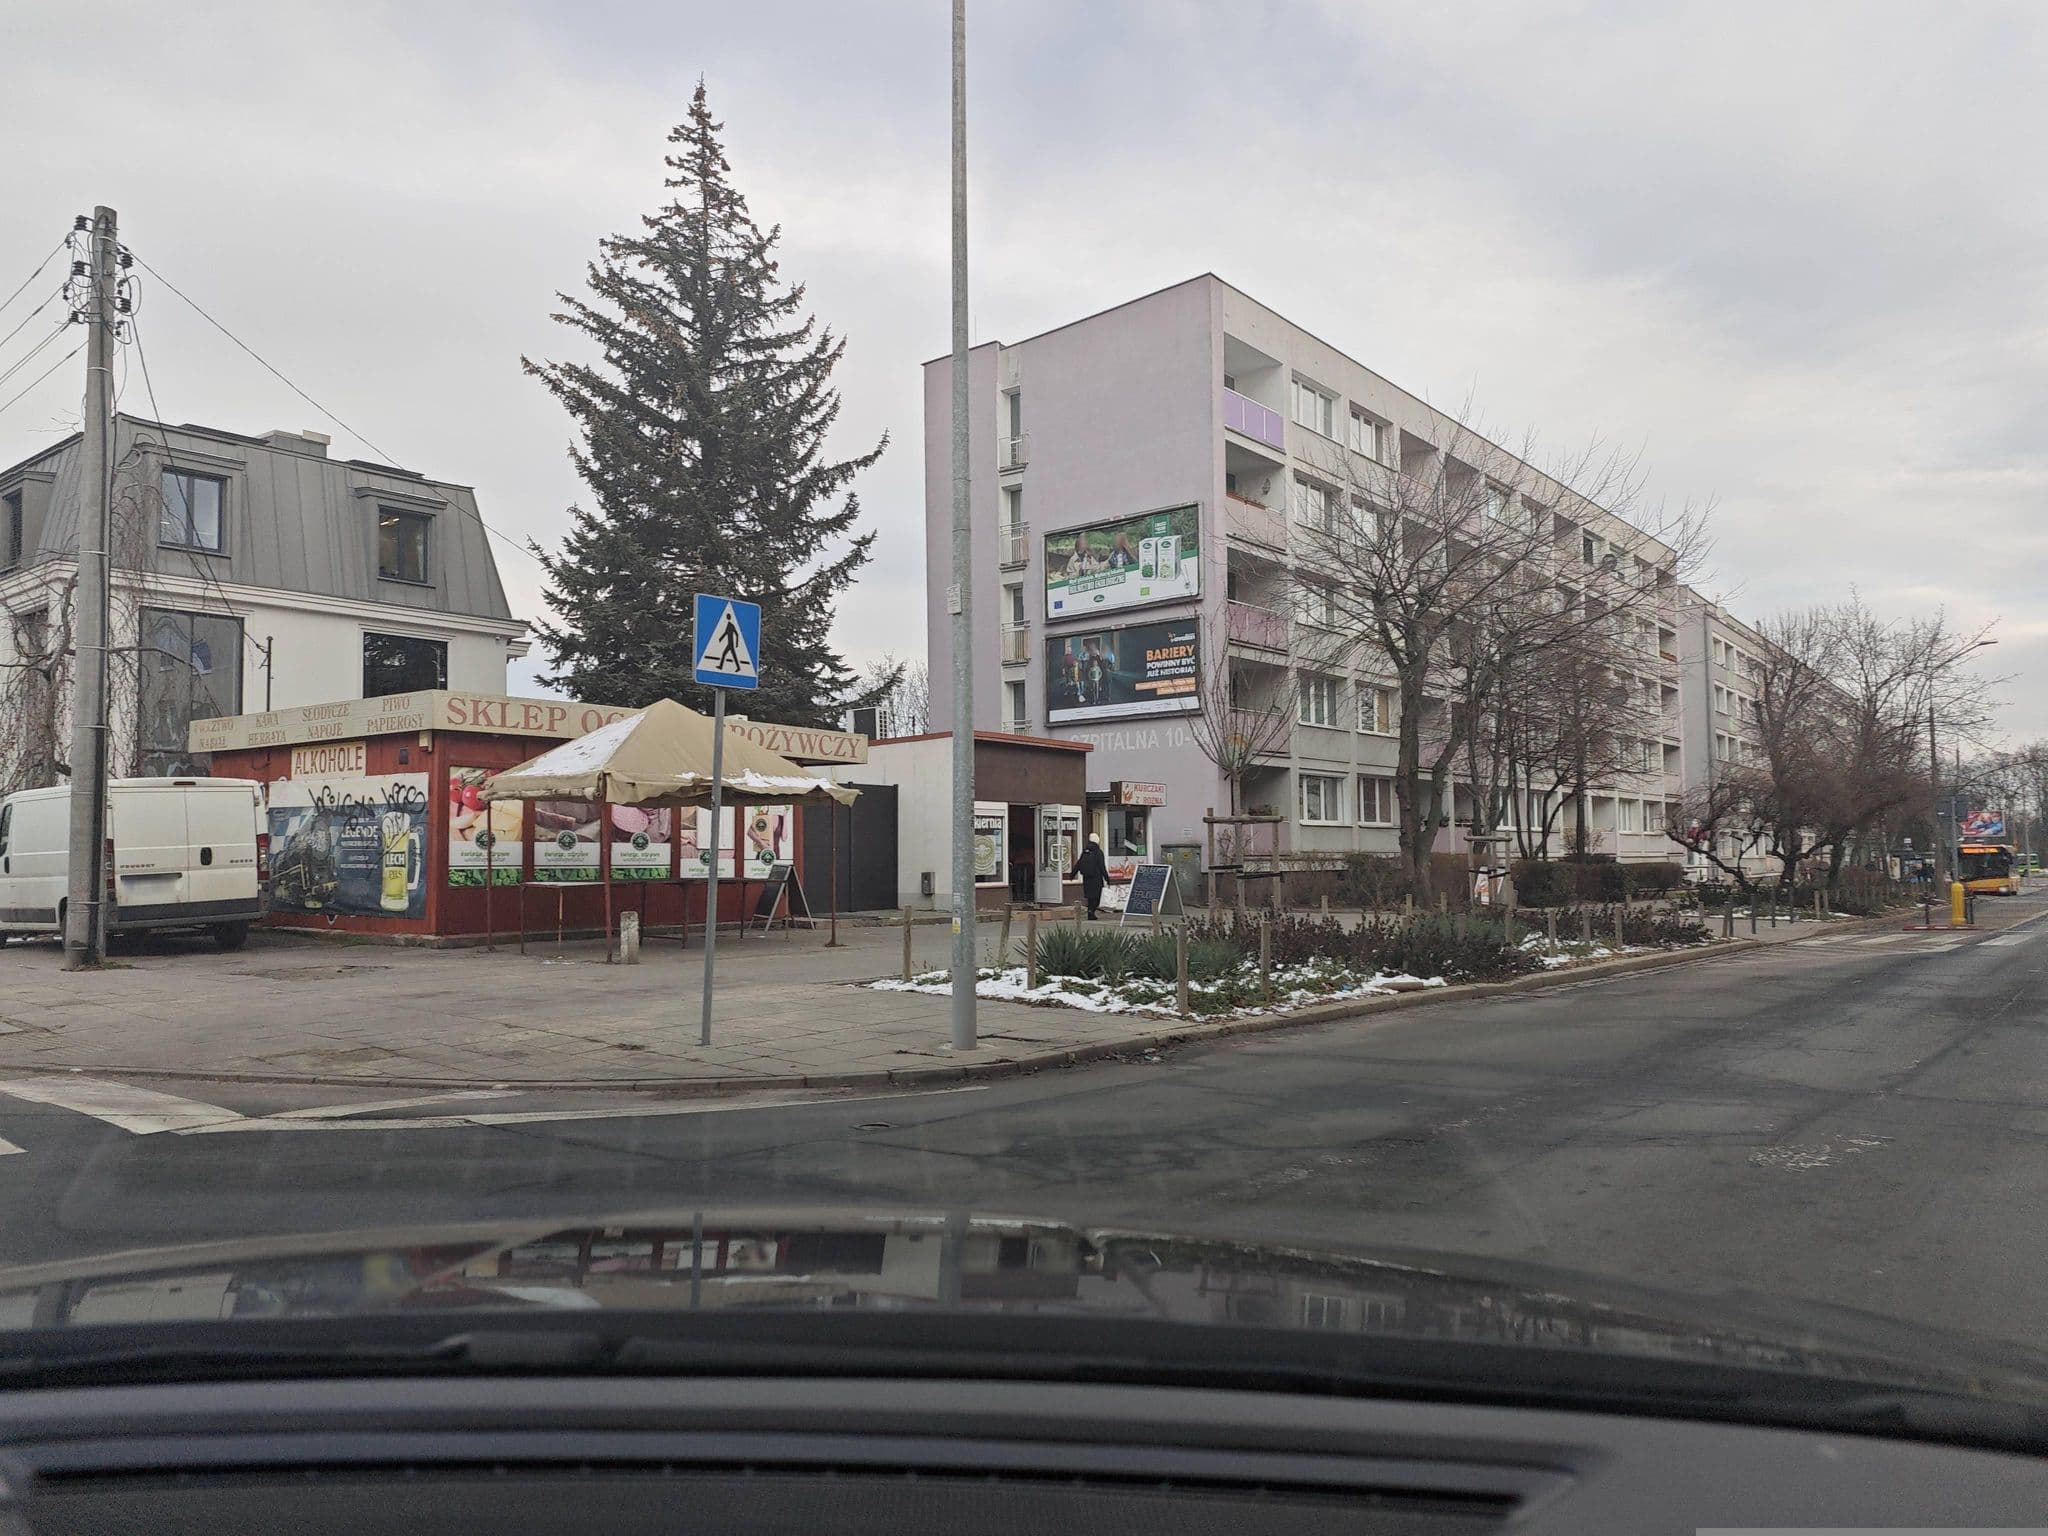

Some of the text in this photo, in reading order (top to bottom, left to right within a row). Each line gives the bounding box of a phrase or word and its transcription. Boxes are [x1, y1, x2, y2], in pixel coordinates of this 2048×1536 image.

[1146, 644, 1195, 661] BARIERY
[1146, 656, 1196, 669] POWINNY BYĆ
[1146, 670, 1160, 678] JUŻ
[382, 695, 410, 712] PIWO
[255, 712, 279, 728] KAWA
[302, 703, 351, 722] SŁODYCZE
[446, 697, 568, 732] SKLEP
[307, 722, 344, 740] NAPOJE
[367, 713, 424, 733] PAPIEROSY
[248, 730, 287, 746] HERBATA
[294, 745, 363, 775] ALKOHOLE
[1133, 784, 1164, 793] KURCZAKI
[385, 853, 405, 866] LECH
